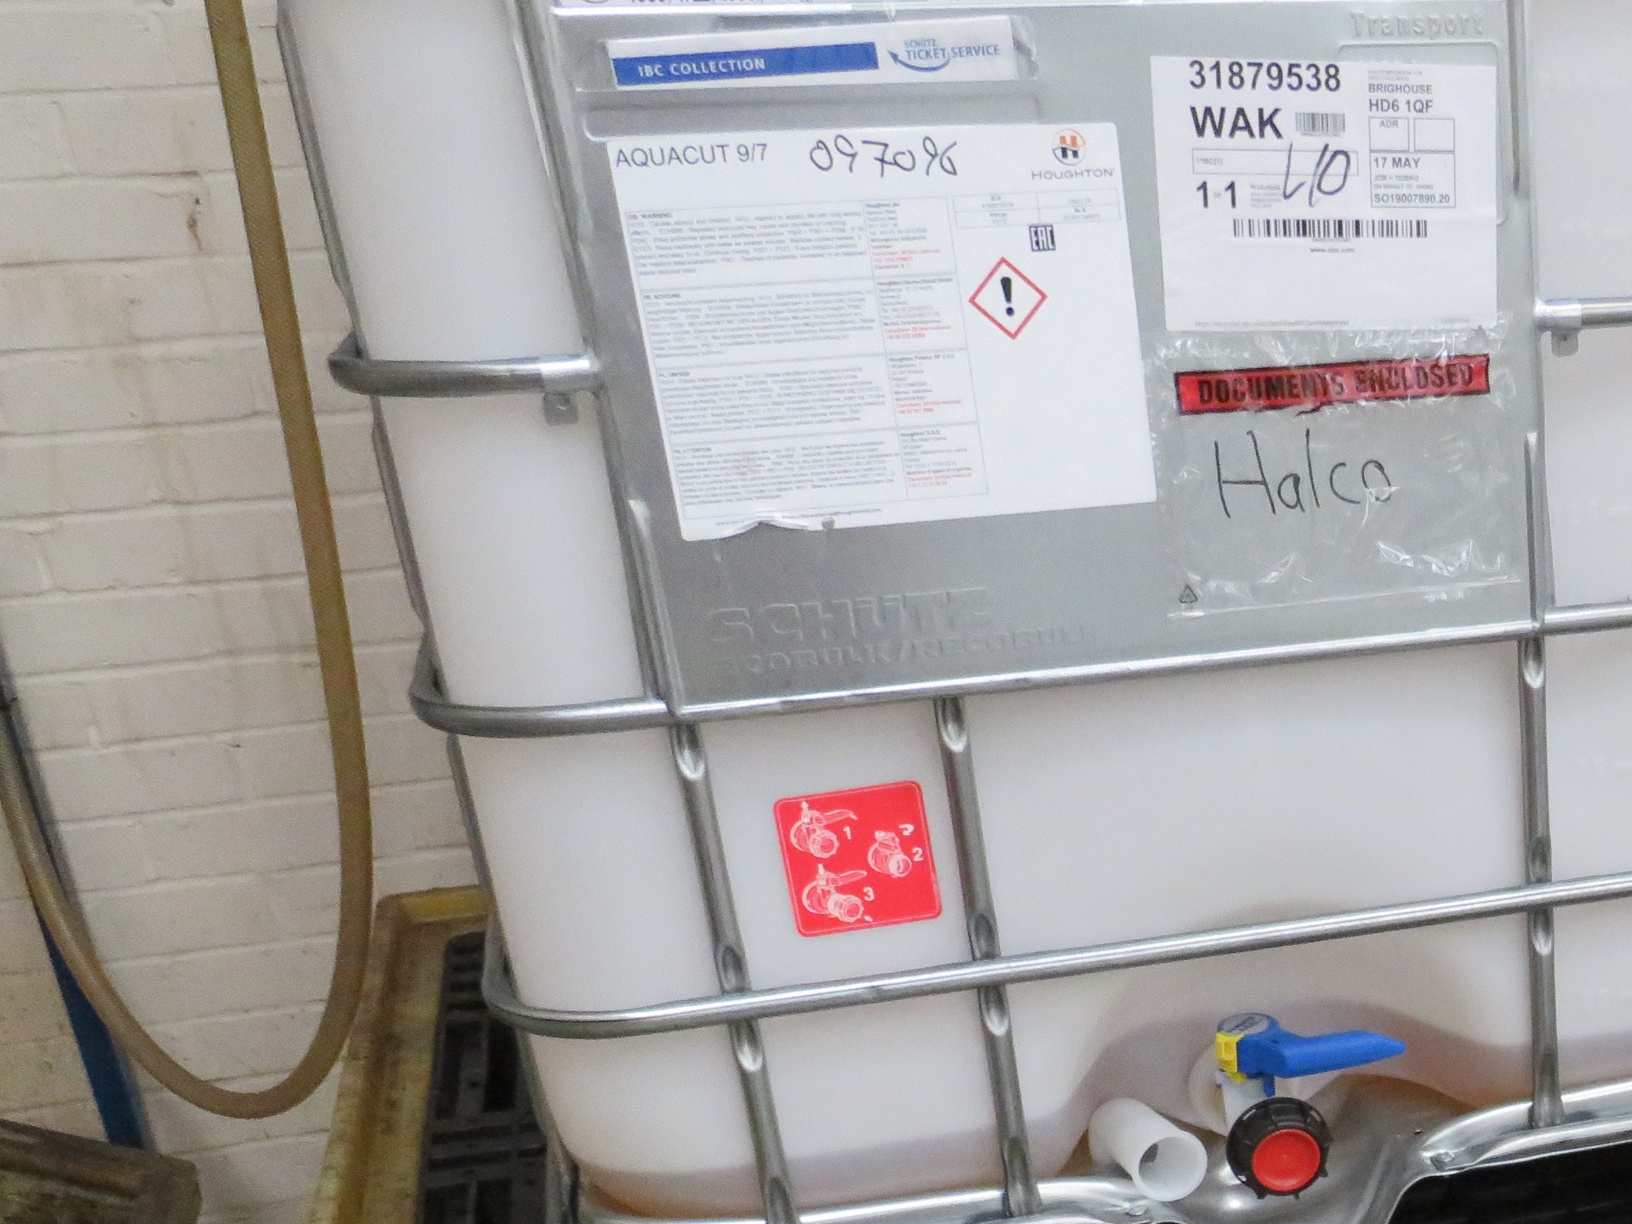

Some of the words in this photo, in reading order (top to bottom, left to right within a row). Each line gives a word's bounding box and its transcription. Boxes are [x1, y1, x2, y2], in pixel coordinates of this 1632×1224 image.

[905, 48, 947, 61] TICKET
[951, 44, 1001, 58] SERVICE
[638, 64, 664, 78] IBC
[669, 58, 767, 76] COLLECTION
[1189, 59, 1341, 93] 31879538
[1368, 83, 1433, 95] BRIGHOUSE
[1368, 98, 1400, 113] HD6
[1405, 99, 1434, 114] 1QF
[1189, 105, 1284, 140] WAK
[1379, 120, 1399, 129] ADR
[615, 144, 731, 169] AQUACUT
[736, 142, 768, 164] 9/7
[1374, 157, 1388, 169] 17
[1392, 157, 1421, 169] MAY
[1031, 169, 1114, 180] HOUGHTON
[1196, 180, 1209, 209] 1
[1225, 180, 1237, 209] 1
[1198, 371, 1346, 404] DOCUMENTS
[1354, 361, 1474, 393] ENCLOSED
[842, 825, 852, 840] 1
[911, 847, 924, 861] 2
[863, 887, 875, 901] 3
